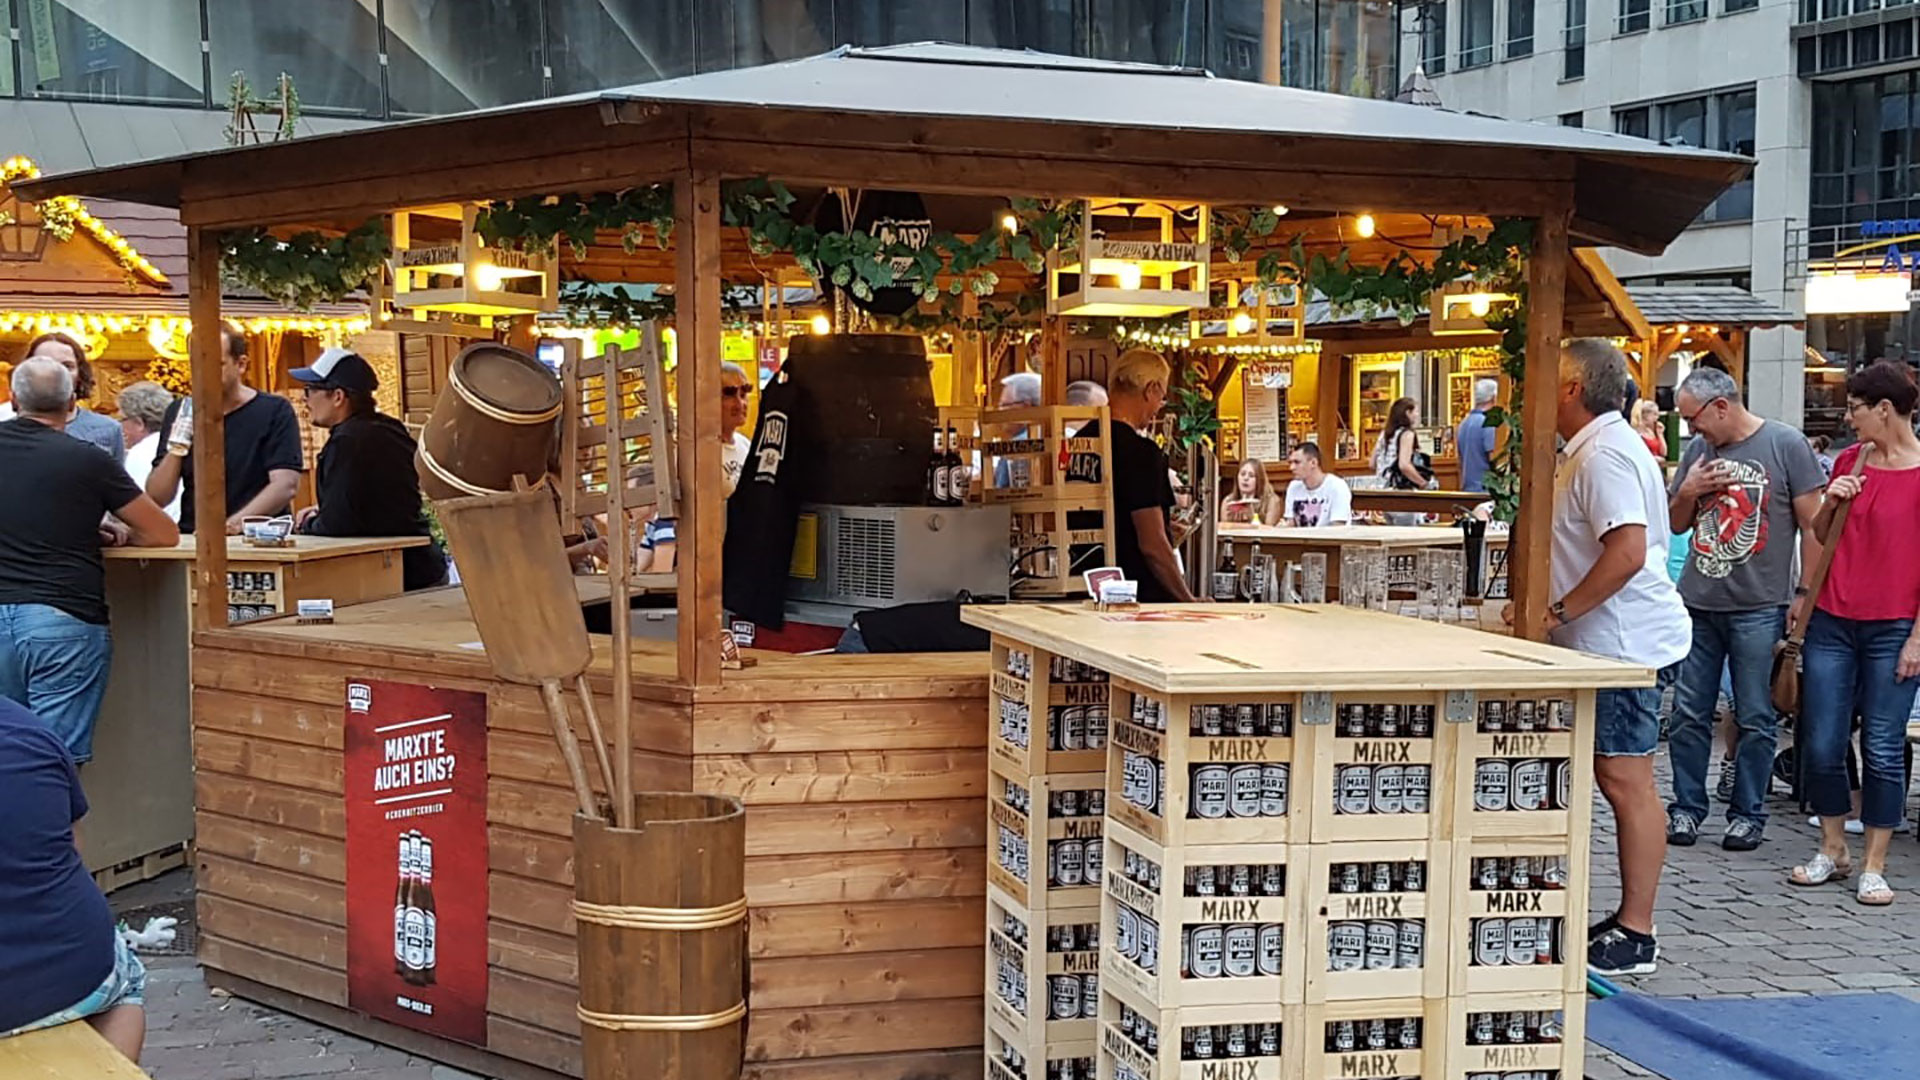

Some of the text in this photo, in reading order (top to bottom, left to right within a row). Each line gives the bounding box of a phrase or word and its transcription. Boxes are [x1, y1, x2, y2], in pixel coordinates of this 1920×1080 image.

[384, 729, 446, 763] MARXT'E
[1208, 739, 1268, 761] MARX
[1353, 741, 1411, 763] MARX
[1493, 735, 1549, 756] MARX
[374, 754, 456, 792] AUCH EINS?
[1065, 820, 1102, 839] MAR
[1202, 899, 1260, 921] MARX
[1345, 895, 1403, 917] MARX
[1486, 891, 1542, 913] MARX
[1063, 952, 1099, 971] MAR
[1341, 1054, 1398, 1077] MARX
[1484, 1046, 1539, 1068] MARX
[1201, 1060, 1259, 1080] MARX
